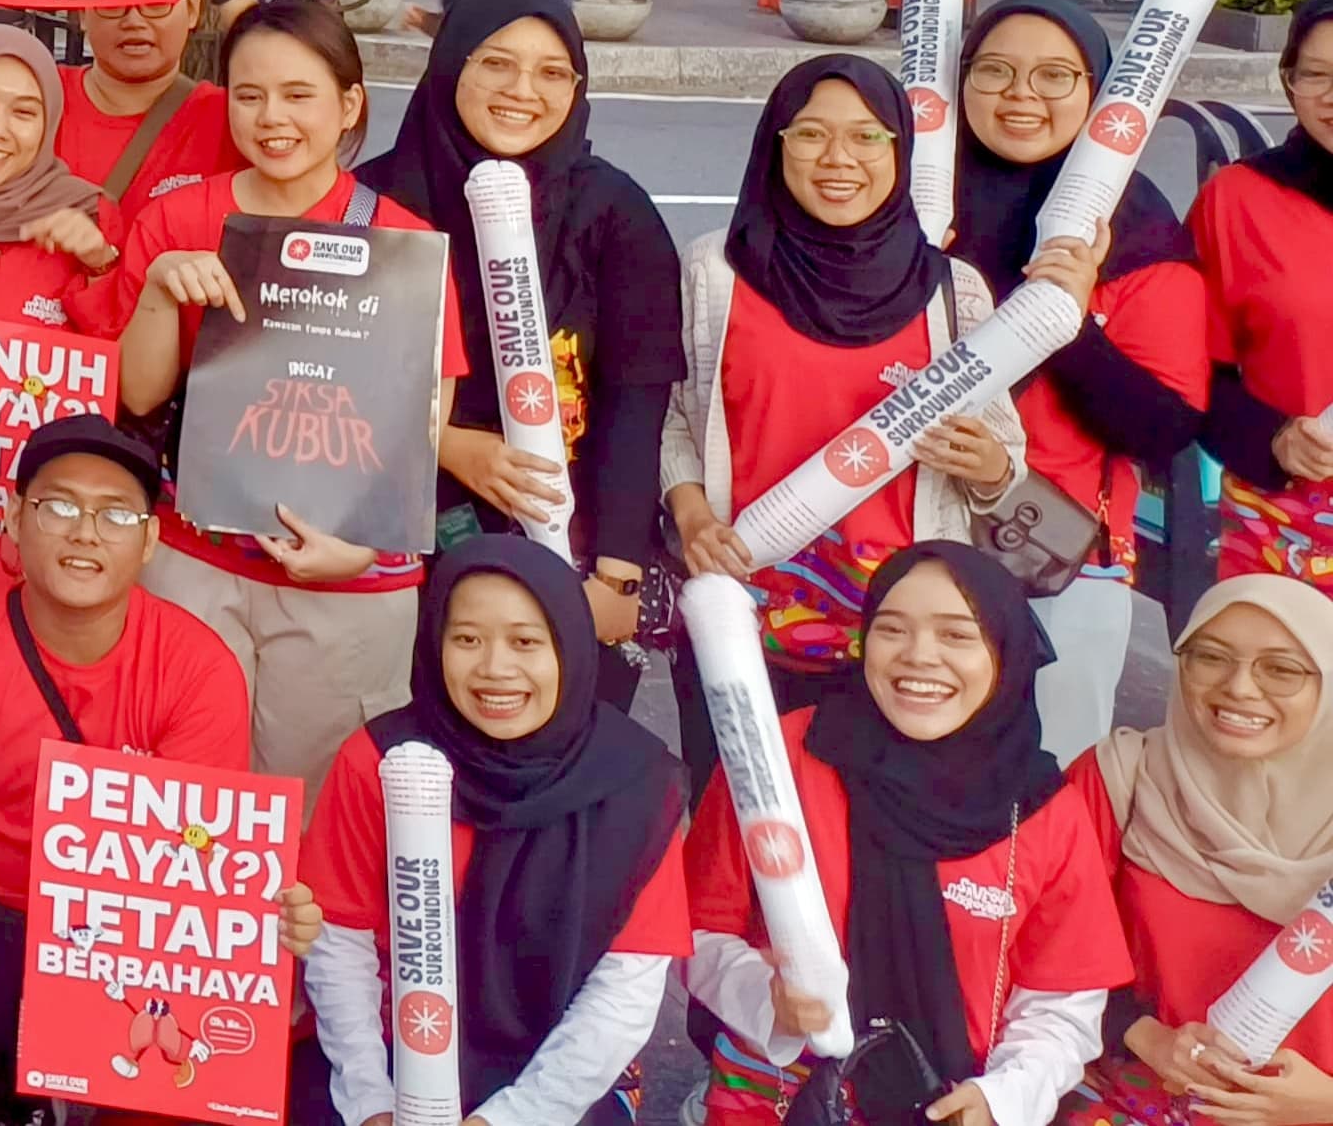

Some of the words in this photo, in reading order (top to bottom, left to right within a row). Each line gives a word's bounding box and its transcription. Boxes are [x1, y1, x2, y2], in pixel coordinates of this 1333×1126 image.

[1108, 46, 1154, 98] SAVE
[1137, 6, 1174, 47] OUR
[1136, 13, 1191, 108] SURROUNDINGS
[314, 241, 339, 253] SAVE
[341, 244, 364, 255] OUR
[260, 282, 348, 314] Merokok
[358, 295, 380, 317] di
[488, 258, 513, 308] OUR
[513, 256, 542, 367] SURROUNDINGS
[288, 360, 336, 381] INGAT
[493, 310, 525, 368] SAVE
[257, 377, 356, 415] SIKSA
[870, 373, 932, 431] SAVE
[934, 341, 978, 387] OUR
[886, 360, 993, 448] SURROUNDINGS
[227, 404, 384, 473] KUBUR
[48, 760, 287, 845] PENUH
[395, 856, 421, 912] OUR
[39, 881, 280, 966] TETAPI
[398, 916, 424, 985] SAVE
[422, 858, 443, 986] SURROUNDINGS
[37, 943, 280, 1007] BERBAHAYA
